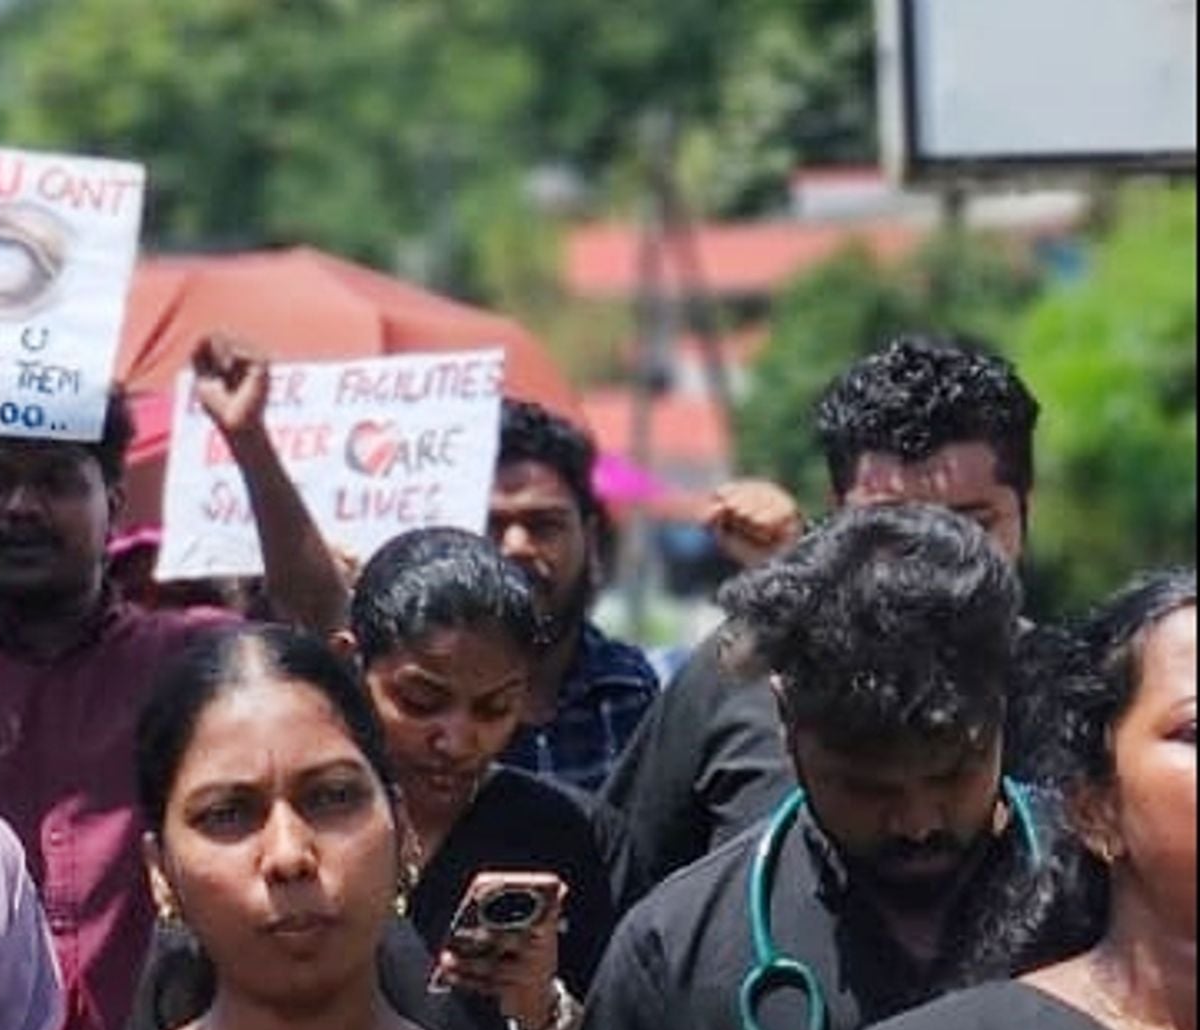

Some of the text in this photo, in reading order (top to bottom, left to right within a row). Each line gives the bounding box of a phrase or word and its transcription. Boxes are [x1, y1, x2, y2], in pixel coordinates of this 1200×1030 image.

[20, 327, 50, 352] U
[16, 358, 81, 395] THEM
[334, 358, 504, 405] FACILITIES
